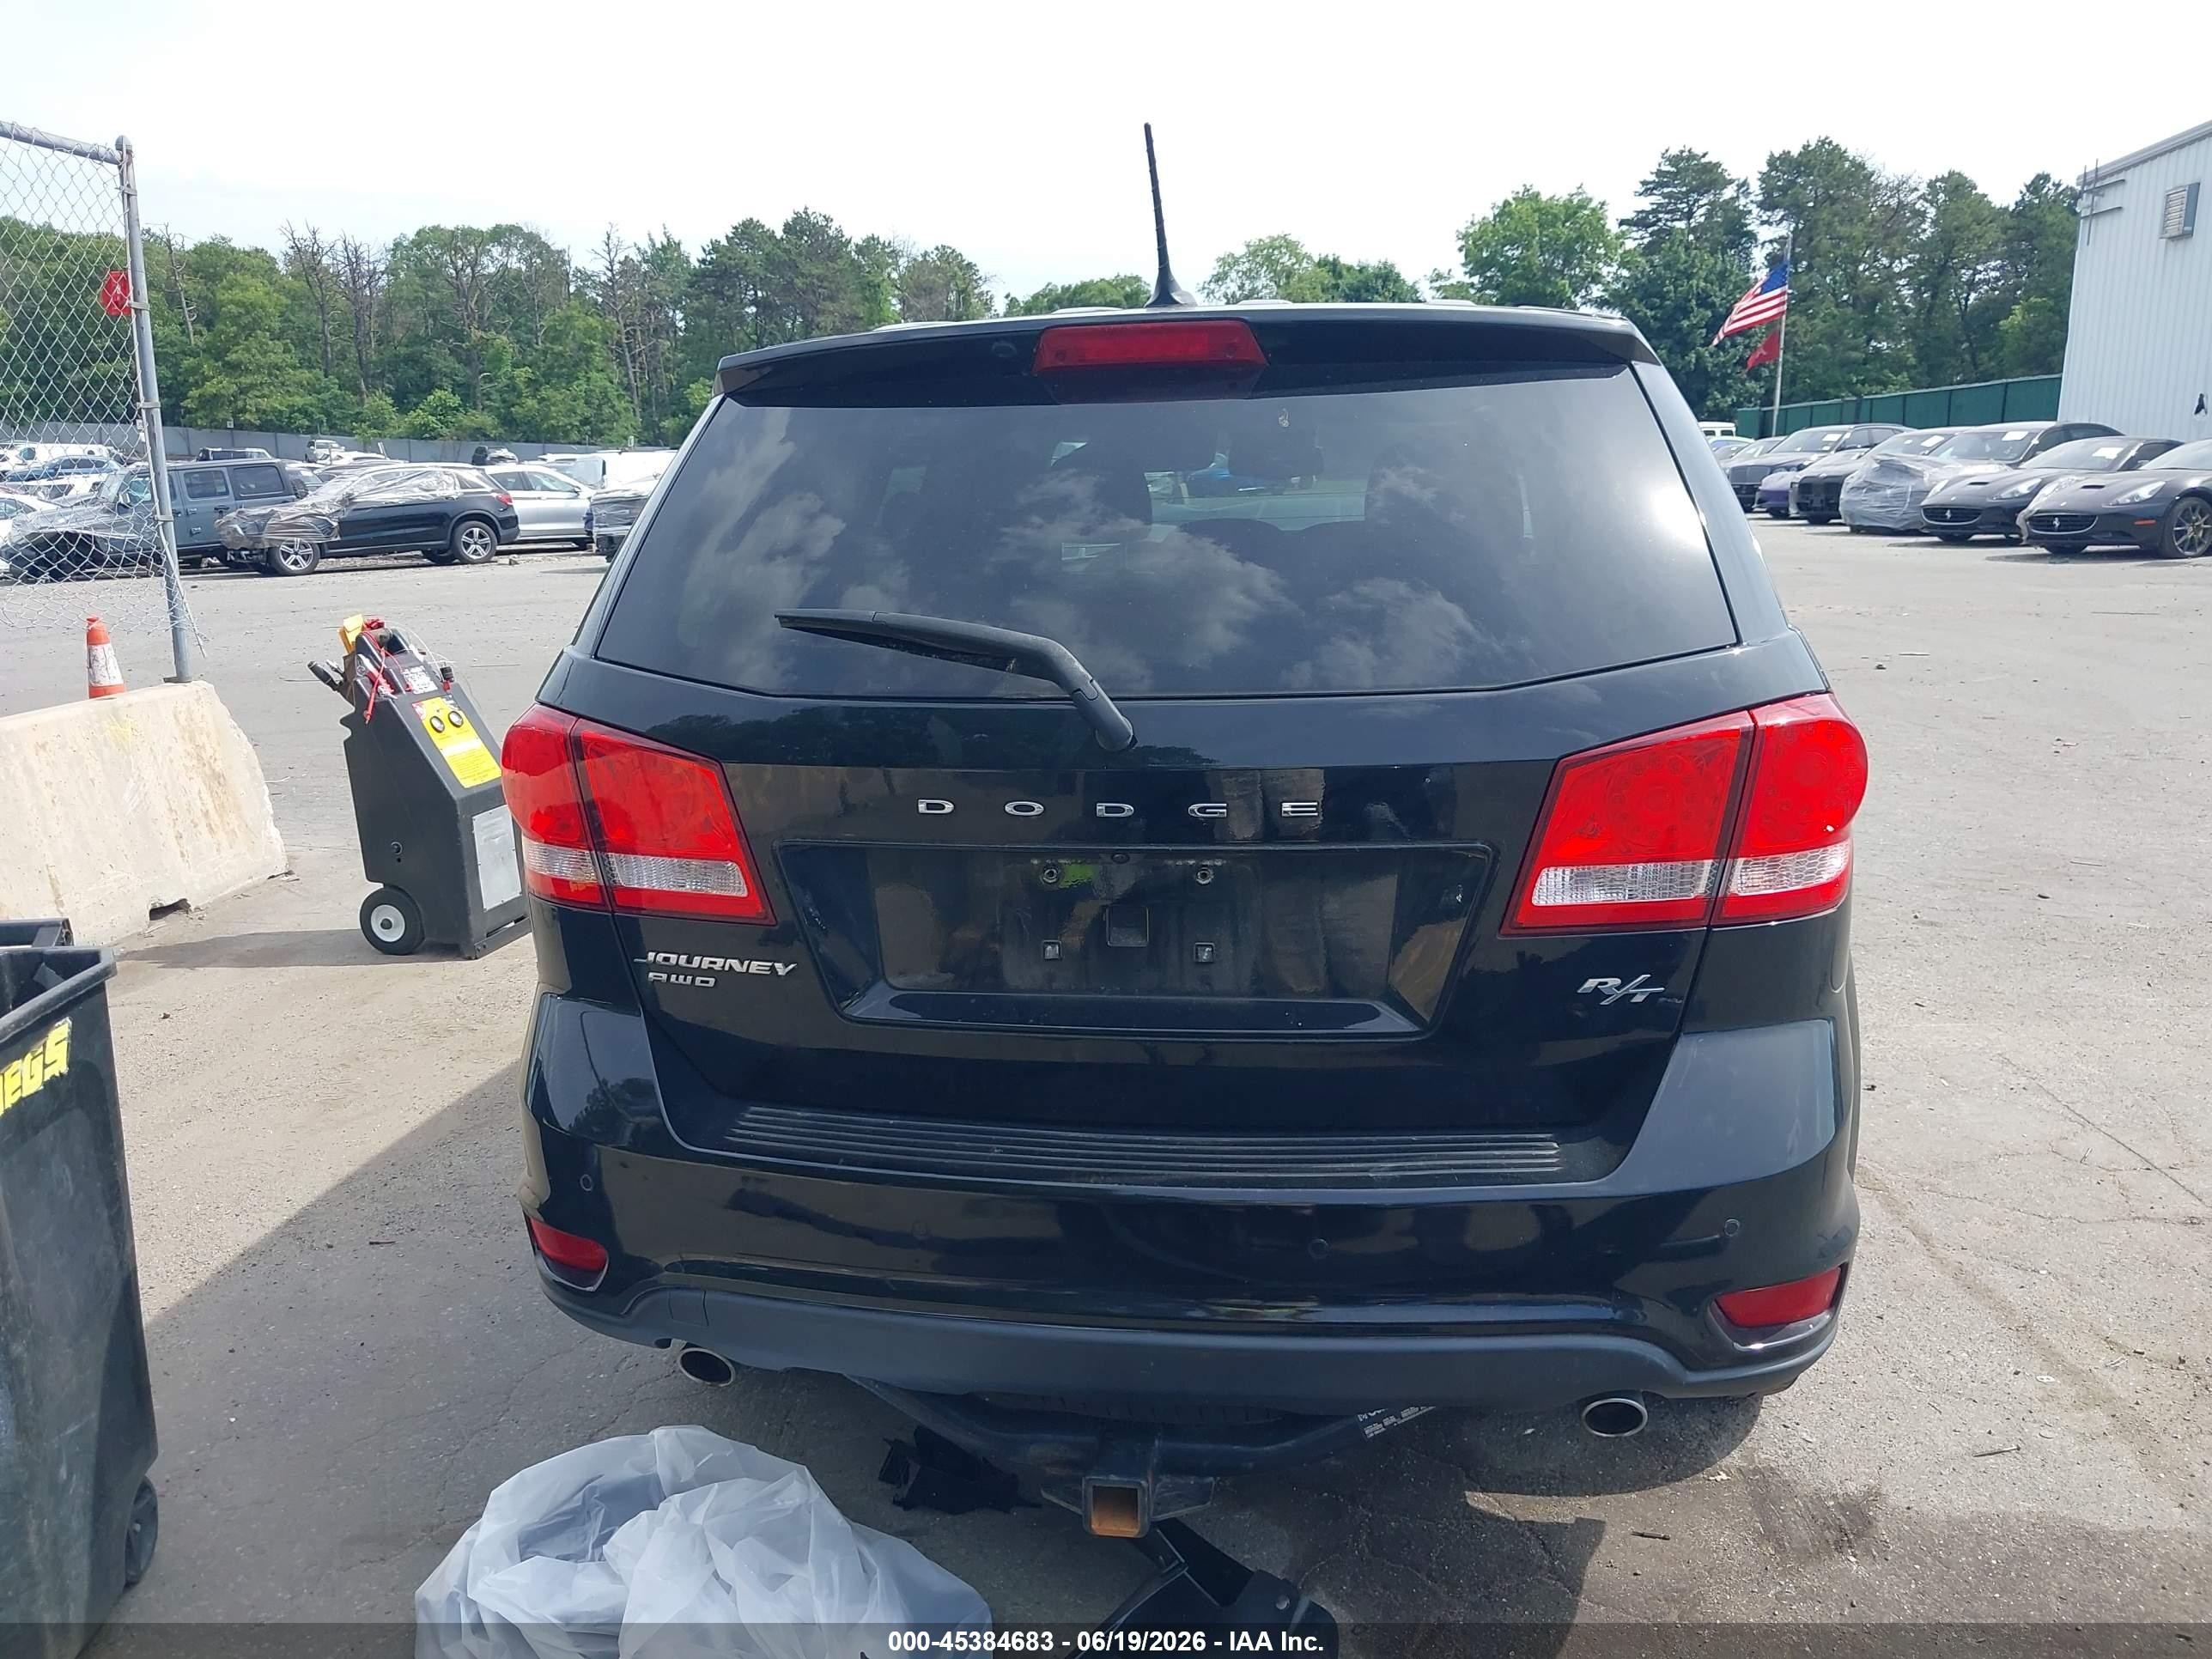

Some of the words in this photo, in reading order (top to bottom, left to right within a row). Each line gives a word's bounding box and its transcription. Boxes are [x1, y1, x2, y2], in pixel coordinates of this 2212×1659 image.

[917, 798, 1320, 818] DODGE
[634, 951, 798, 977] JOURNEY
[647, 971, 716, 988] AWD
[1577, 974, 1666, 1006] R/T
[0, 1017, 72, 1116] EGS
